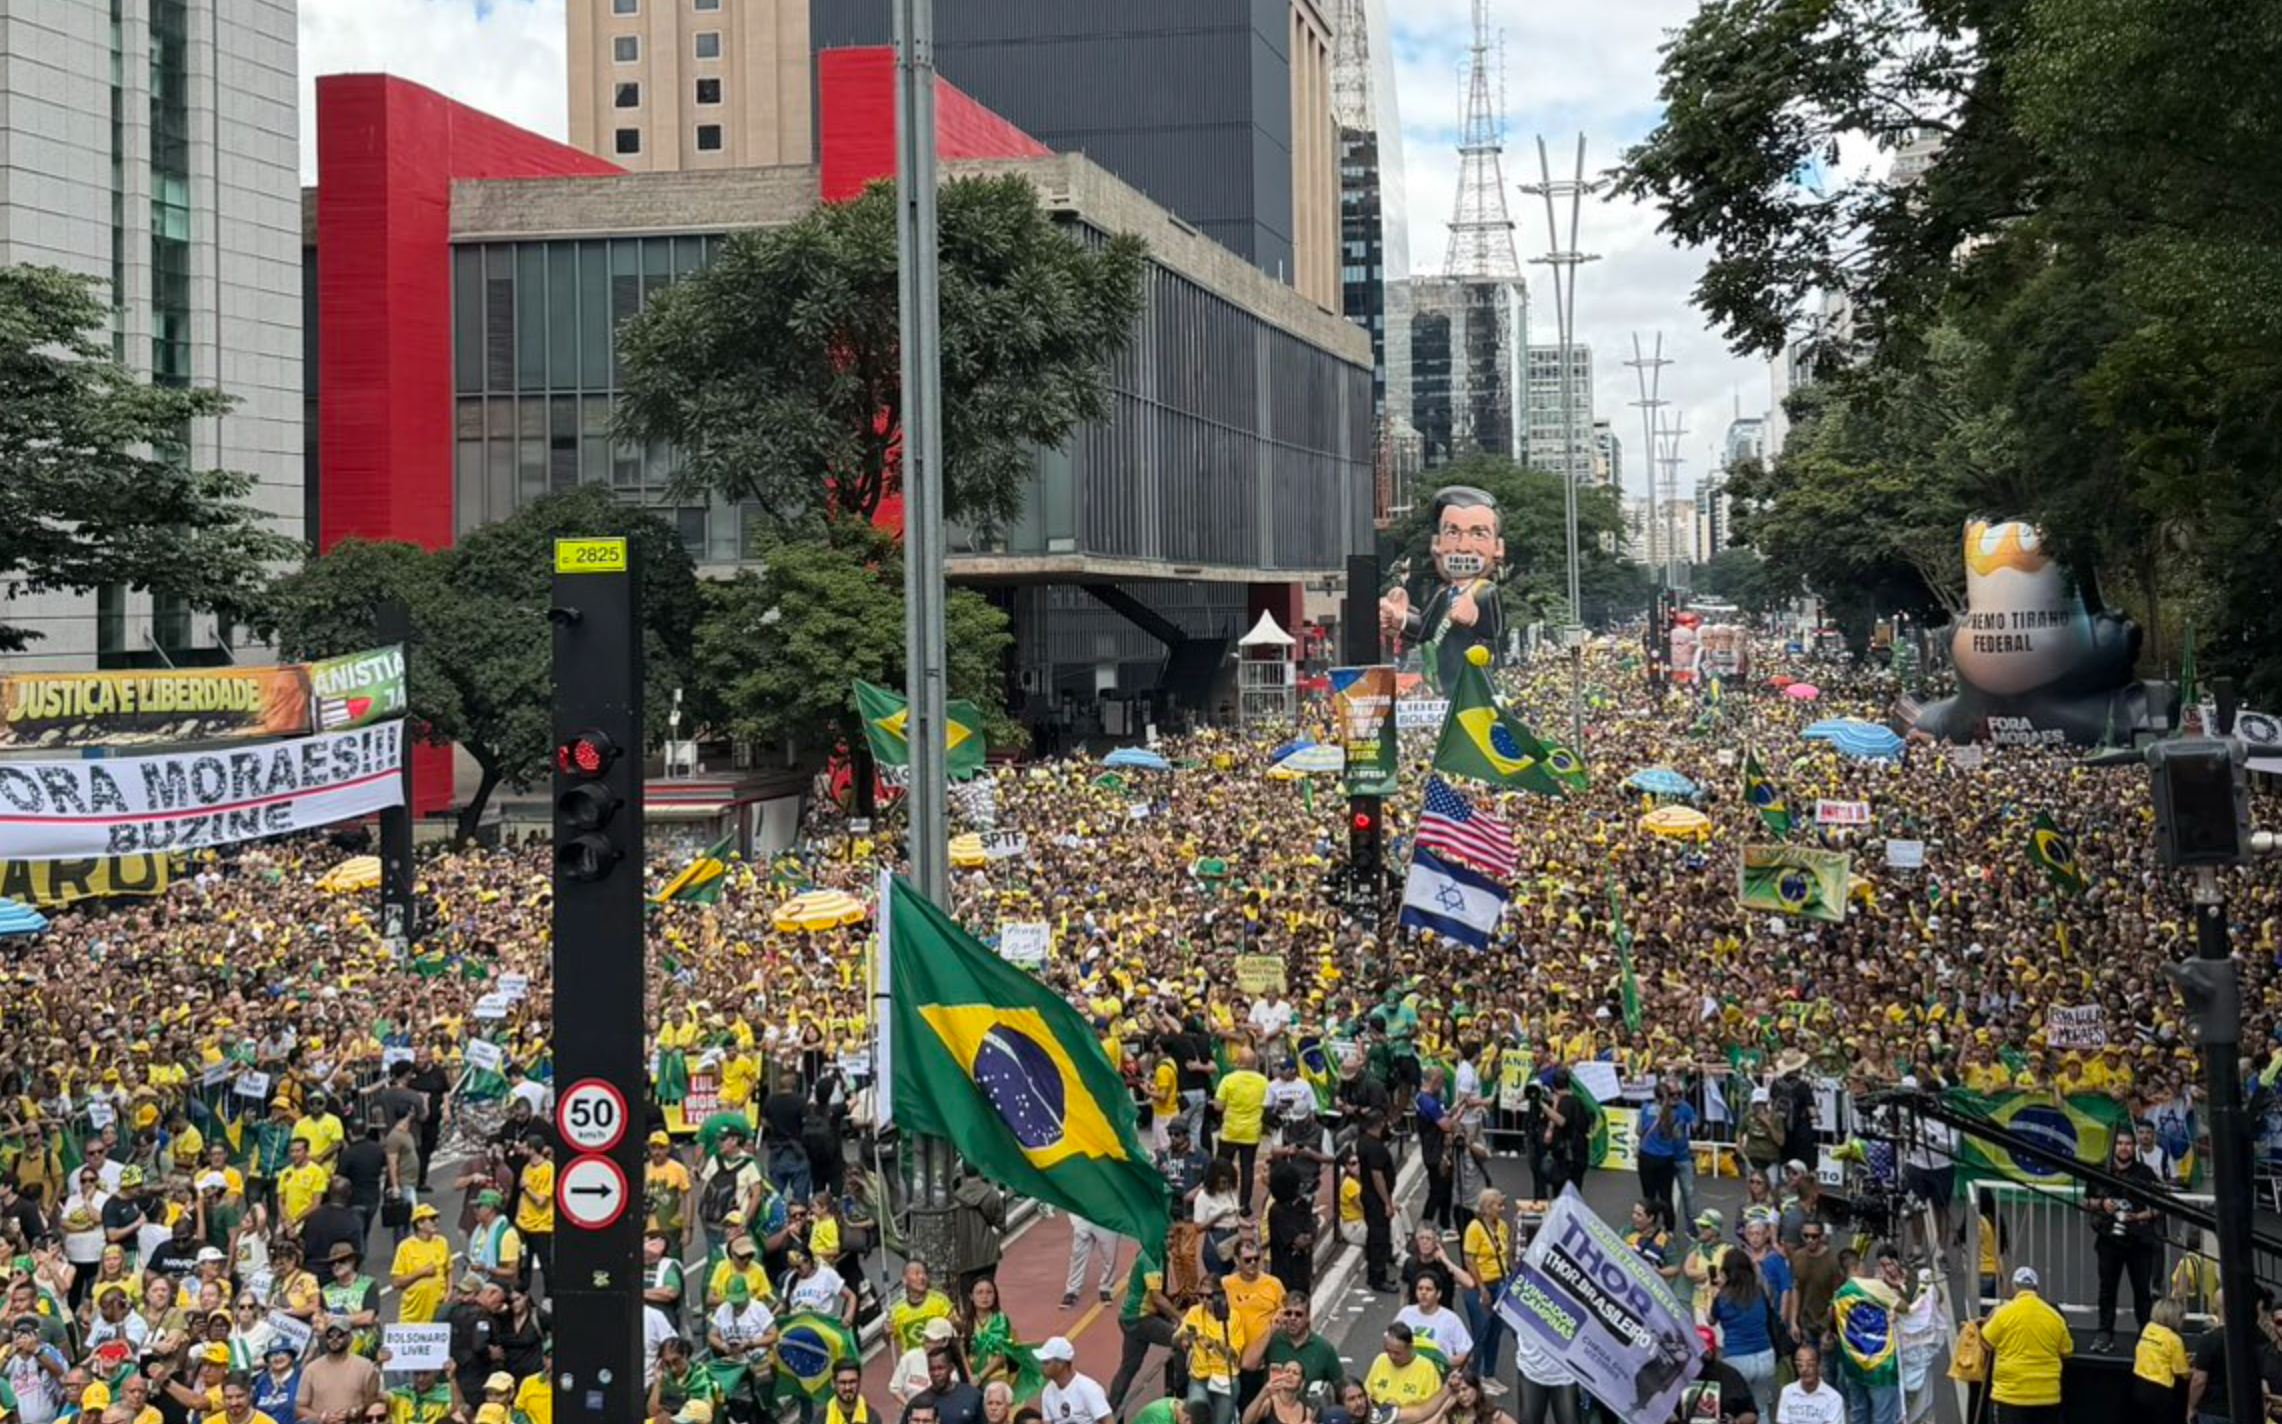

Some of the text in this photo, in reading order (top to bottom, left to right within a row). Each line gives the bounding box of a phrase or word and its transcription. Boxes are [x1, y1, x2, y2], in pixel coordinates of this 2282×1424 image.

[576, 547, 619, 563] 2825
[2011, 610, 2069, 629] TIRANO
[1973, 634, 2033, 653] FEDERAL
[314, 655, 404, 697] ANISTIA
[6, 677, 261, 722] JUSTIÇA E LIBERDADE
[383, 680, 405, 713] JÁ
[1987, 716, 2034, 731] FORA
[1991, 728, 2065, 744] MORAES
[106, 801, 295, 854] BUZINE
[691, 1075, 716, 1092] LUL
[1512, 1070, 1522, 1090] J
[571, 1098, 613, 1128] 50
[1559, 1213, 1652, 1317] THOR
[1518, 1290, 1577, 1341] CAMPINAS
[387, 1332, 449, 1344] BOLSONARO
[402, 1344, 431, 1356] LIVRE
